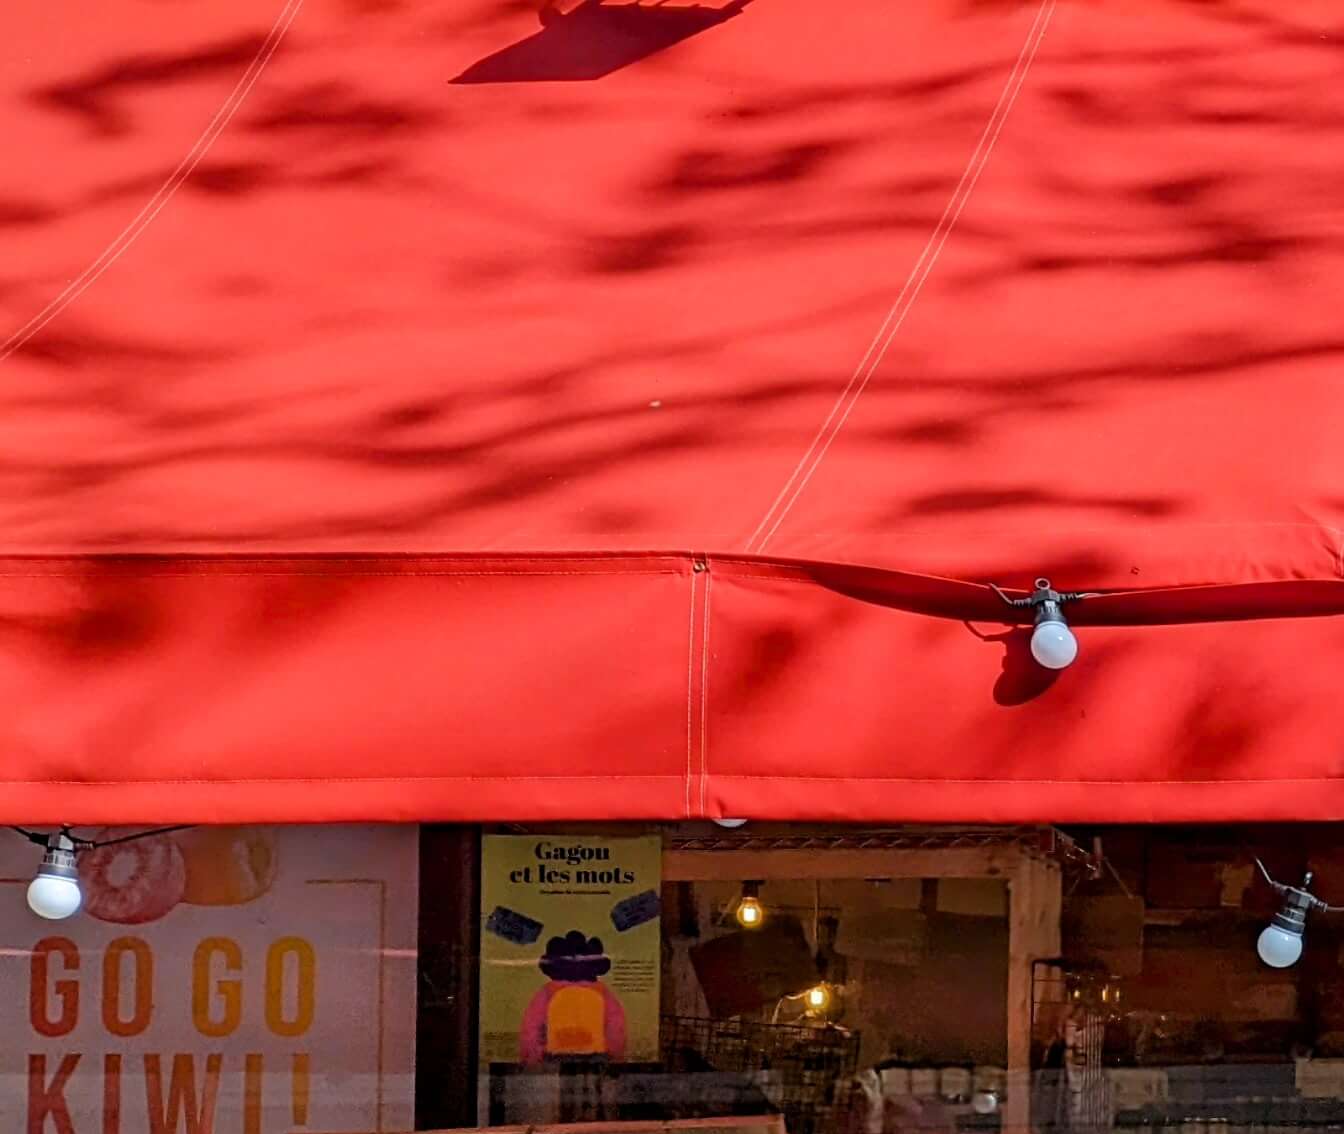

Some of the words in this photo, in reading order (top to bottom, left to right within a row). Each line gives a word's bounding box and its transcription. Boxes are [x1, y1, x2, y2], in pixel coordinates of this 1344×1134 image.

[534, 841, 609, 865] Gagou
[510, 866, 532, 884] et
[540, 864, 571, 884] les
[576, 866, 635, 884] mots
[30, 936, 154, 1037] GO
[191, 936, 316, 1037] GO
